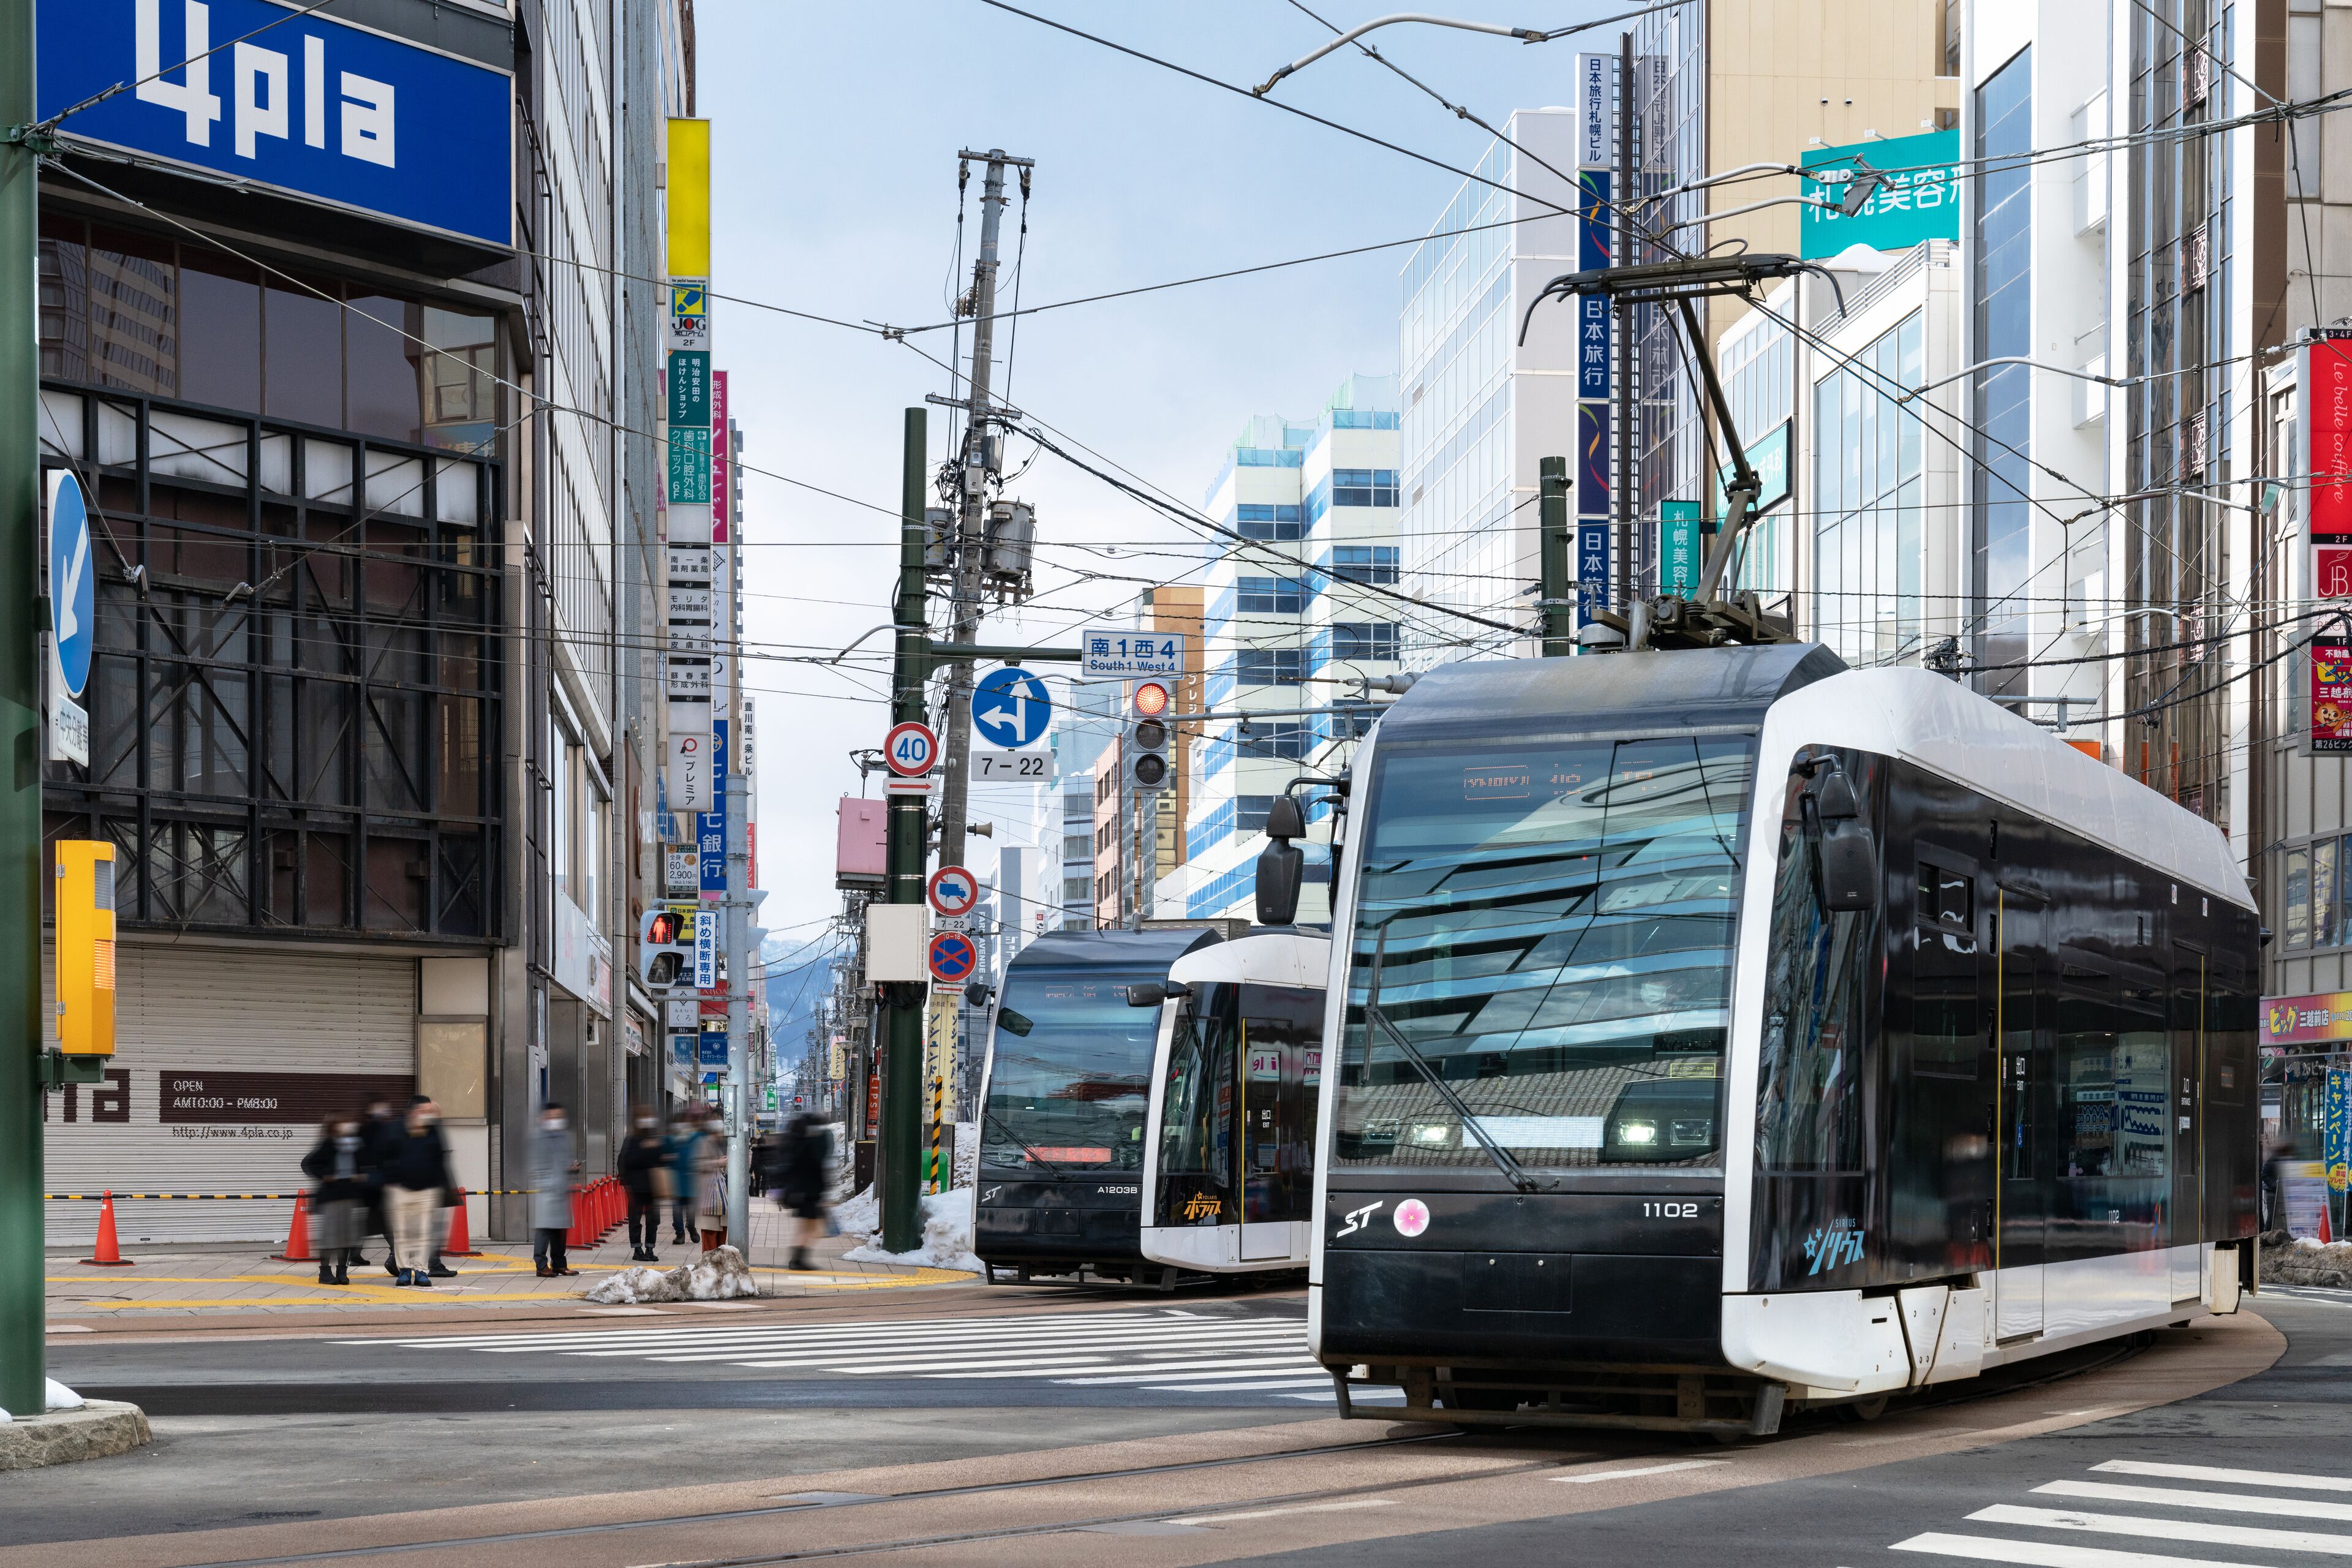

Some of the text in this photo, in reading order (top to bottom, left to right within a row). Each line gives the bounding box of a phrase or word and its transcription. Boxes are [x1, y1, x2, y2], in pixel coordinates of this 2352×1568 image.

[136, 0, 395, 168] 4pla
[1589, 59, 1601, 162] 日本旅行札幌ビル
[672, 317, 706, 330] JOG
[1585, 300, 1604, 385] 日本旅行
[692, 358, 700, 402] 明治安田の
[2334, 384, 2348, 431] belle
[672, 430, 680, 474] クリニック
[684, 430, 695, 500] 歯科口腔外科
[2331, 432, 2348, 503] coiffure
[671, 556, 708, 564] 南一条
[2316, 659, 2352, 685] ビッ
[61, 706, 88, 753] 中央分離帯
[896, 737, 925, 761] 40
[685, 761, 695, 805] プレミア
[669, 871, 696, 880] 2,900円
[699, 915, 711, 984] 斜め横断専用
[2269, 1004, 2299, 1037] ビッグ
[2299, 1009, 2329, 1028] 三越前店
[928, 1012, 941, 1093] ソシュンドウ
[173, 1080, 203, 1091] OPEN
[173, 1098, 224, 1109] AM10:00
[237, 1098, 277, 1109] PM8:00
[173, 1126, 293, 1140] http://www.4pla.co.jp
[1262, 1109, 1271, 1120] 出口
[2329, 1074, 2342, 1160] キャンペーン
[1183, 1191, 1221, 1220] ポラリス
[1336, 1200, 1384, 1238] ST
[1643, 1203, 1697, 1218] 1102
[1835, 1218, 1856, 1228] SIRIUS
[2108, 1210, 2119, 1224] 1102
[1803, 1219, 1864, 1276] シリウス
